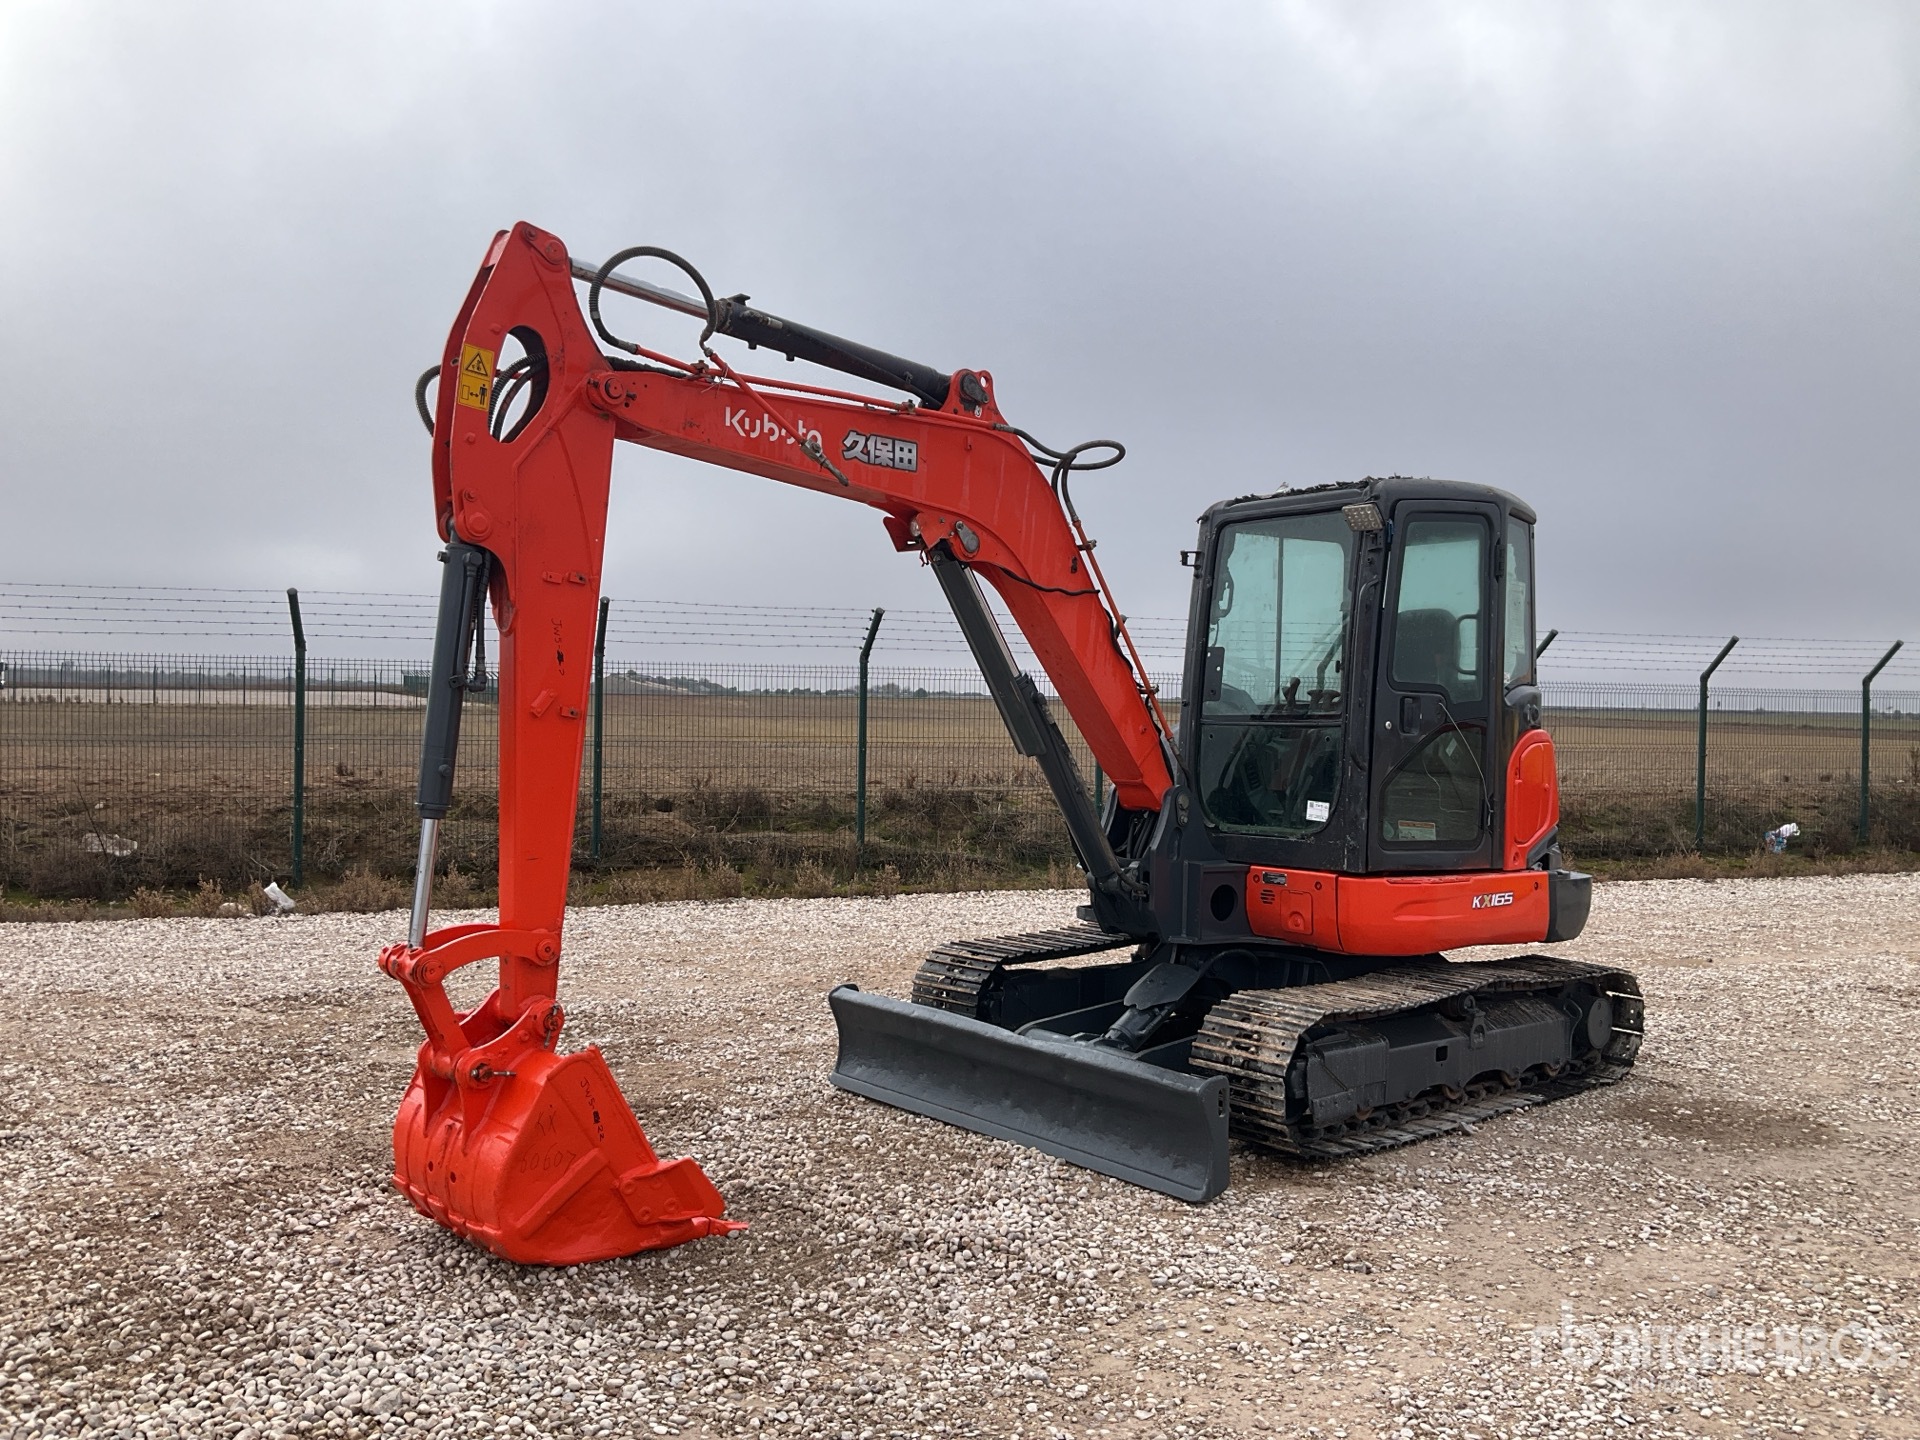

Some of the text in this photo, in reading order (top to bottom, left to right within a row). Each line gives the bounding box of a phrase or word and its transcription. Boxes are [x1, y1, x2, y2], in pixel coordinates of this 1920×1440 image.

[842, 430, 918, 474] 久保田
[1471, 891, 1514, 910] KX165
